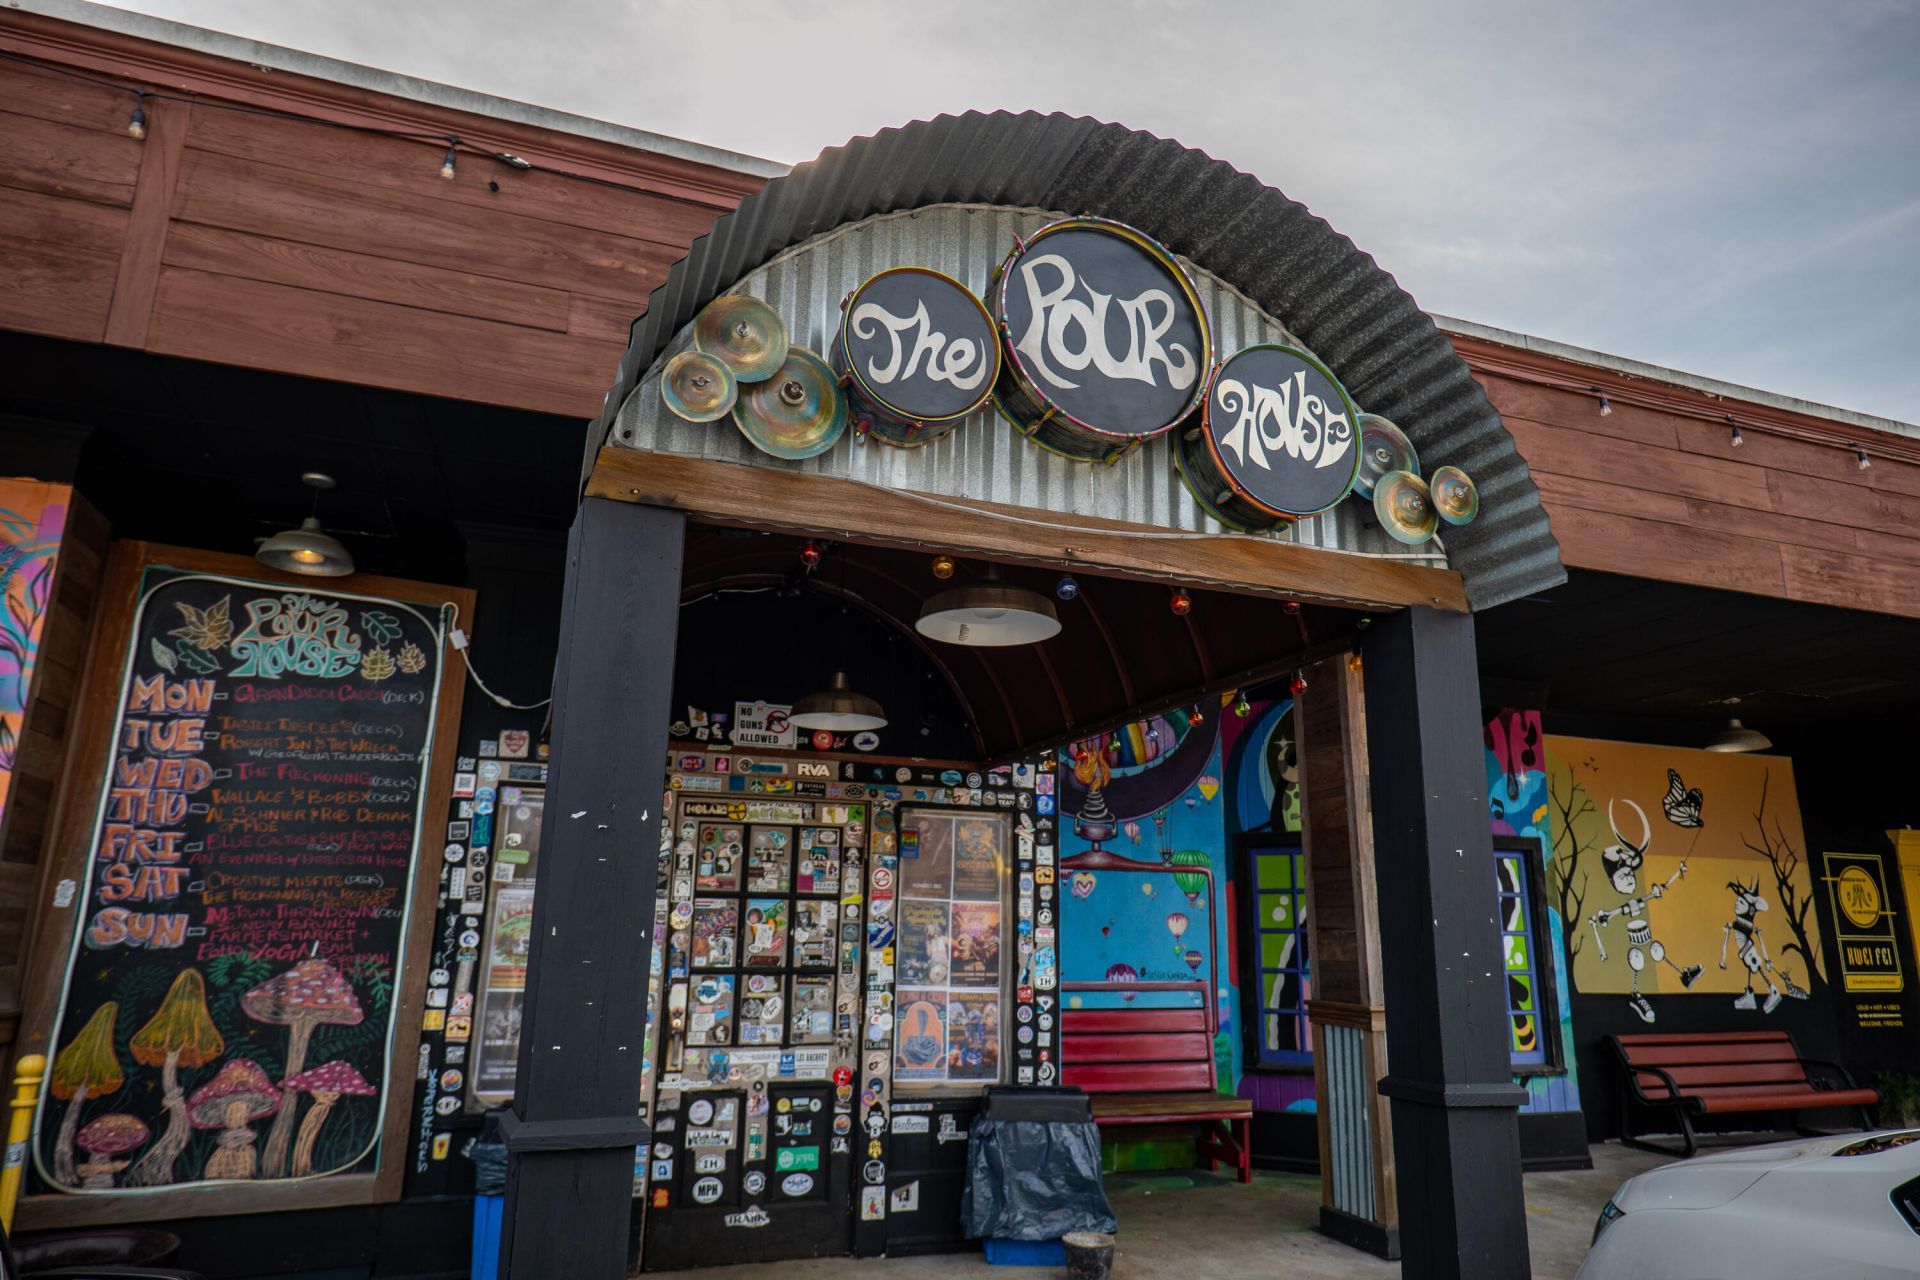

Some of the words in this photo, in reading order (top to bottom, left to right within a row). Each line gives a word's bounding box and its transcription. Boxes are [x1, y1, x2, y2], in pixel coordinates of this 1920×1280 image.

[1017, 253, 1197, 391] POUR
[852, 298, 986, 391] The
[1217, 369, 1354, 470] HOUSE
[227, 634, 361, 679] HOUSE
[127, 673, 216, 716] MON
[740, 706, 753, 717] NO
[352, 721, 404, 738] (DECK)
[739, 719, 763, 731] GUNS
[121, 718, 206, 757] TUE
[739, 733, 779, 744] ALLOWED
[115, 755, 214, 794] WED
[234, 762, 273, 781] THE
[372, 776, 417, 790] (DECK)
[797, 762, 830, 777] RVA
[108, 787, 188, 825] THU
[211, 788, 285, 804] WALLACE
[206, 807, 231, 823] AL
[320, 807, 350, 822] ROB
[98, 823, 187, 864] FRI
[207, 834, 255, 850] BLUE
[97, 863, 190, 904] SAT
[207, 870, 282, 889] CREATIVE
[284, 873, 344, 888] MISFITS
[201, 889, 227, 905] THE
[85, 906, 189, 949] SUN
[1846, 947, 1873, 966] KWEI
[1875, 947, 1892, 966] FEI
[697, 1183, 718, 1197] MPH
